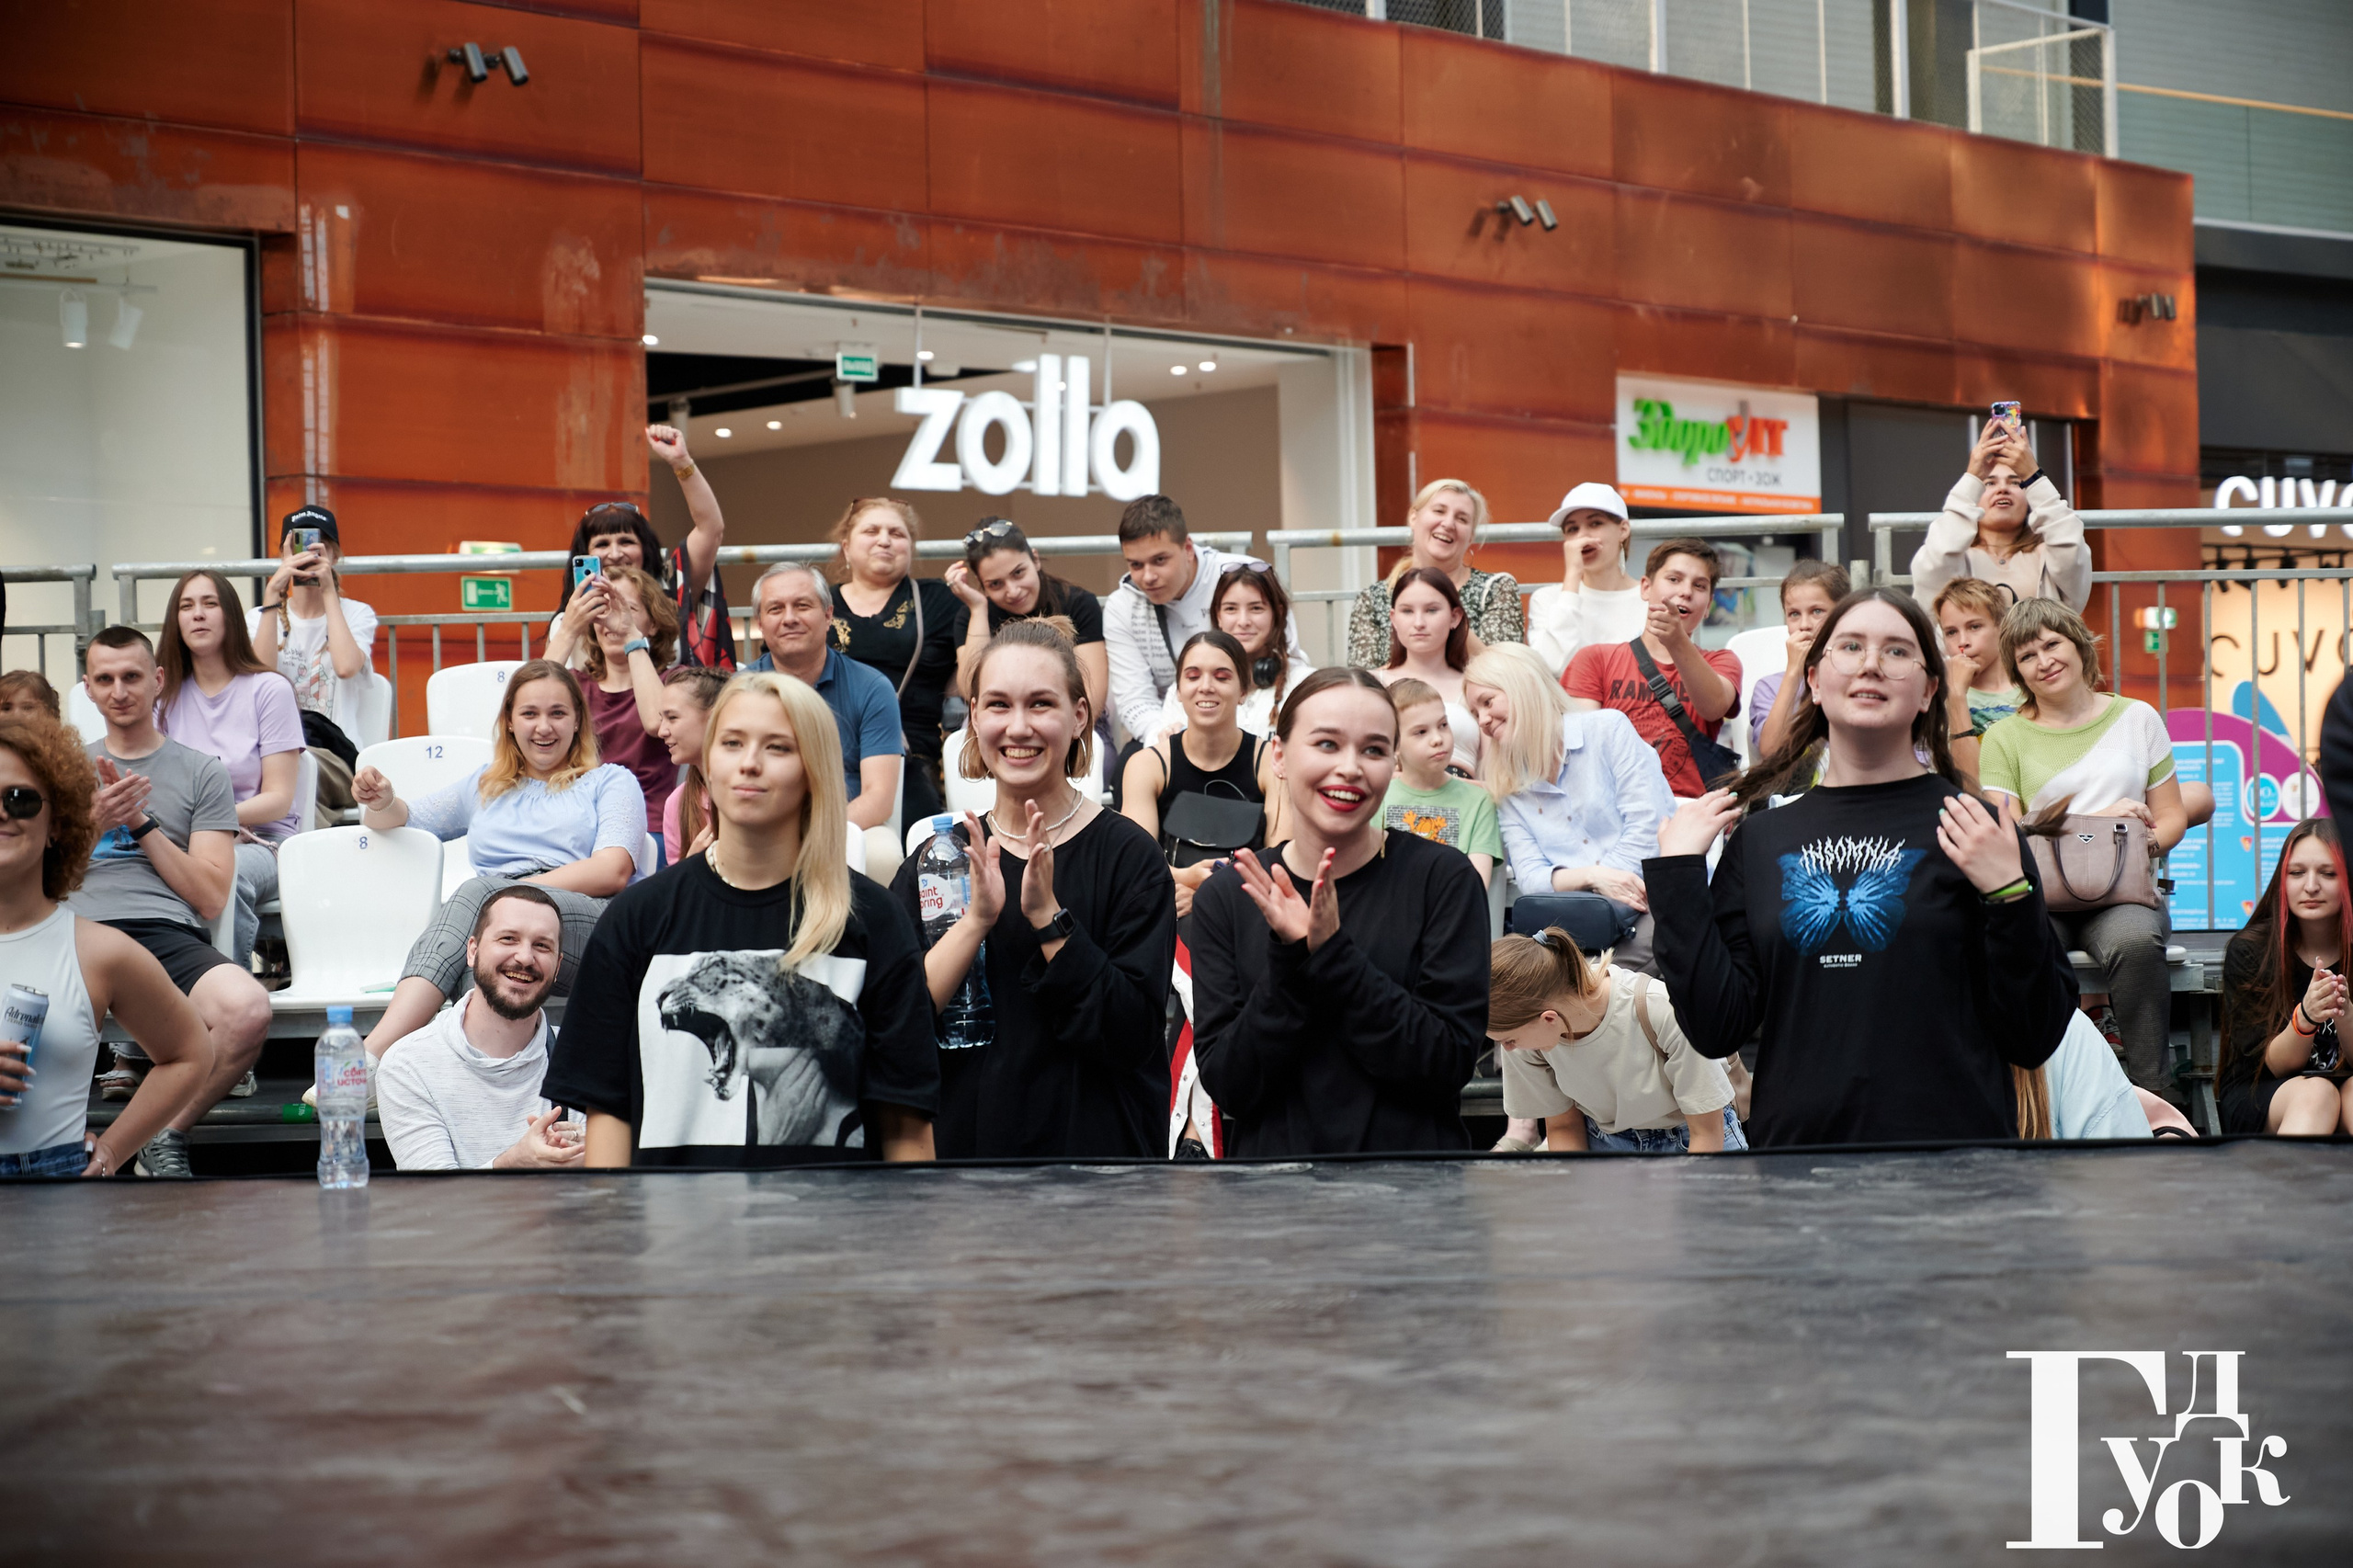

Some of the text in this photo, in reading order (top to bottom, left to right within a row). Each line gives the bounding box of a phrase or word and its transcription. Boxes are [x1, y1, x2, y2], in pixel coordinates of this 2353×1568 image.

[890, 353, 1160, 501] zolla
[497, 671, 505, 682] 8
[426, 745, 443, 758] 12
[358, 836, 368, 849] 8
[1798, 835, 1906, 877] INSOMNIA
[1819, 954, 1862, 964] SETNER
